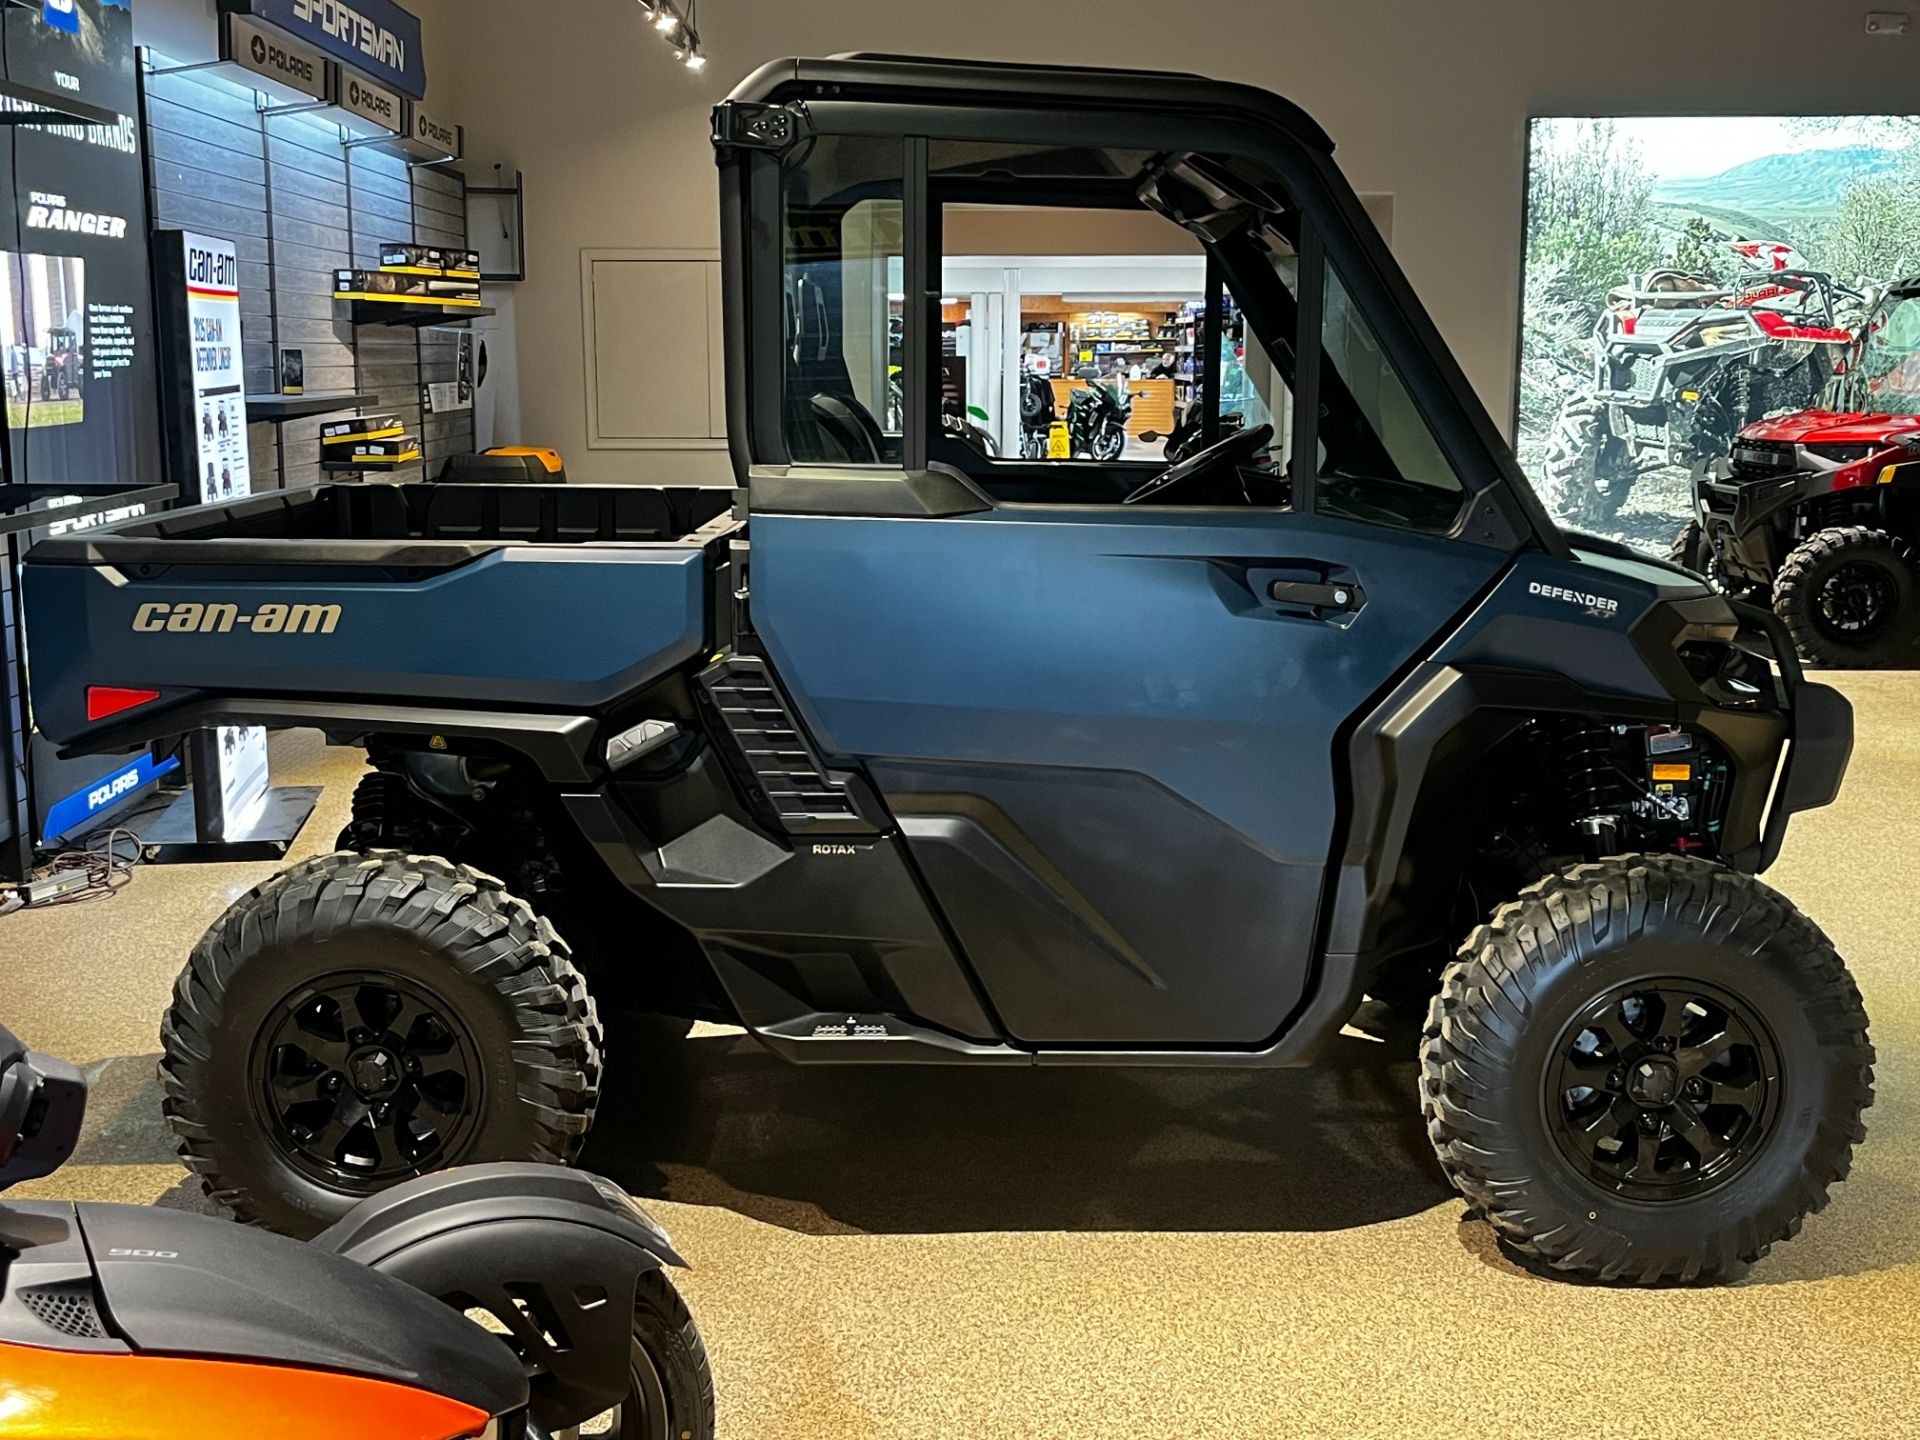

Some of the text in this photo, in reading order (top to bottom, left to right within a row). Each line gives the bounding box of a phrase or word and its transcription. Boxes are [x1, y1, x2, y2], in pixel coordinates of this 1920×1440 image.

[268, 47, 313, 82] POLARIS
[54, 70, 80, 92] YOUR
[361, 89, 391, 118] POLARIS
[428, 122, 453, 146] POLARIS
[30, 191, 66, 208] POLARIS
[26, 205, 127, 238] RANGER
[189, 248, 235, 286] can-am
[1528, 582, 1618, 611] DEFENDER
[132, 602, 342, 633] can-am
[88, 768, 139, 810] POLARIS
[812, 844, 856, 855] ROTAX
[108, 1247, 179, 1258] 900
